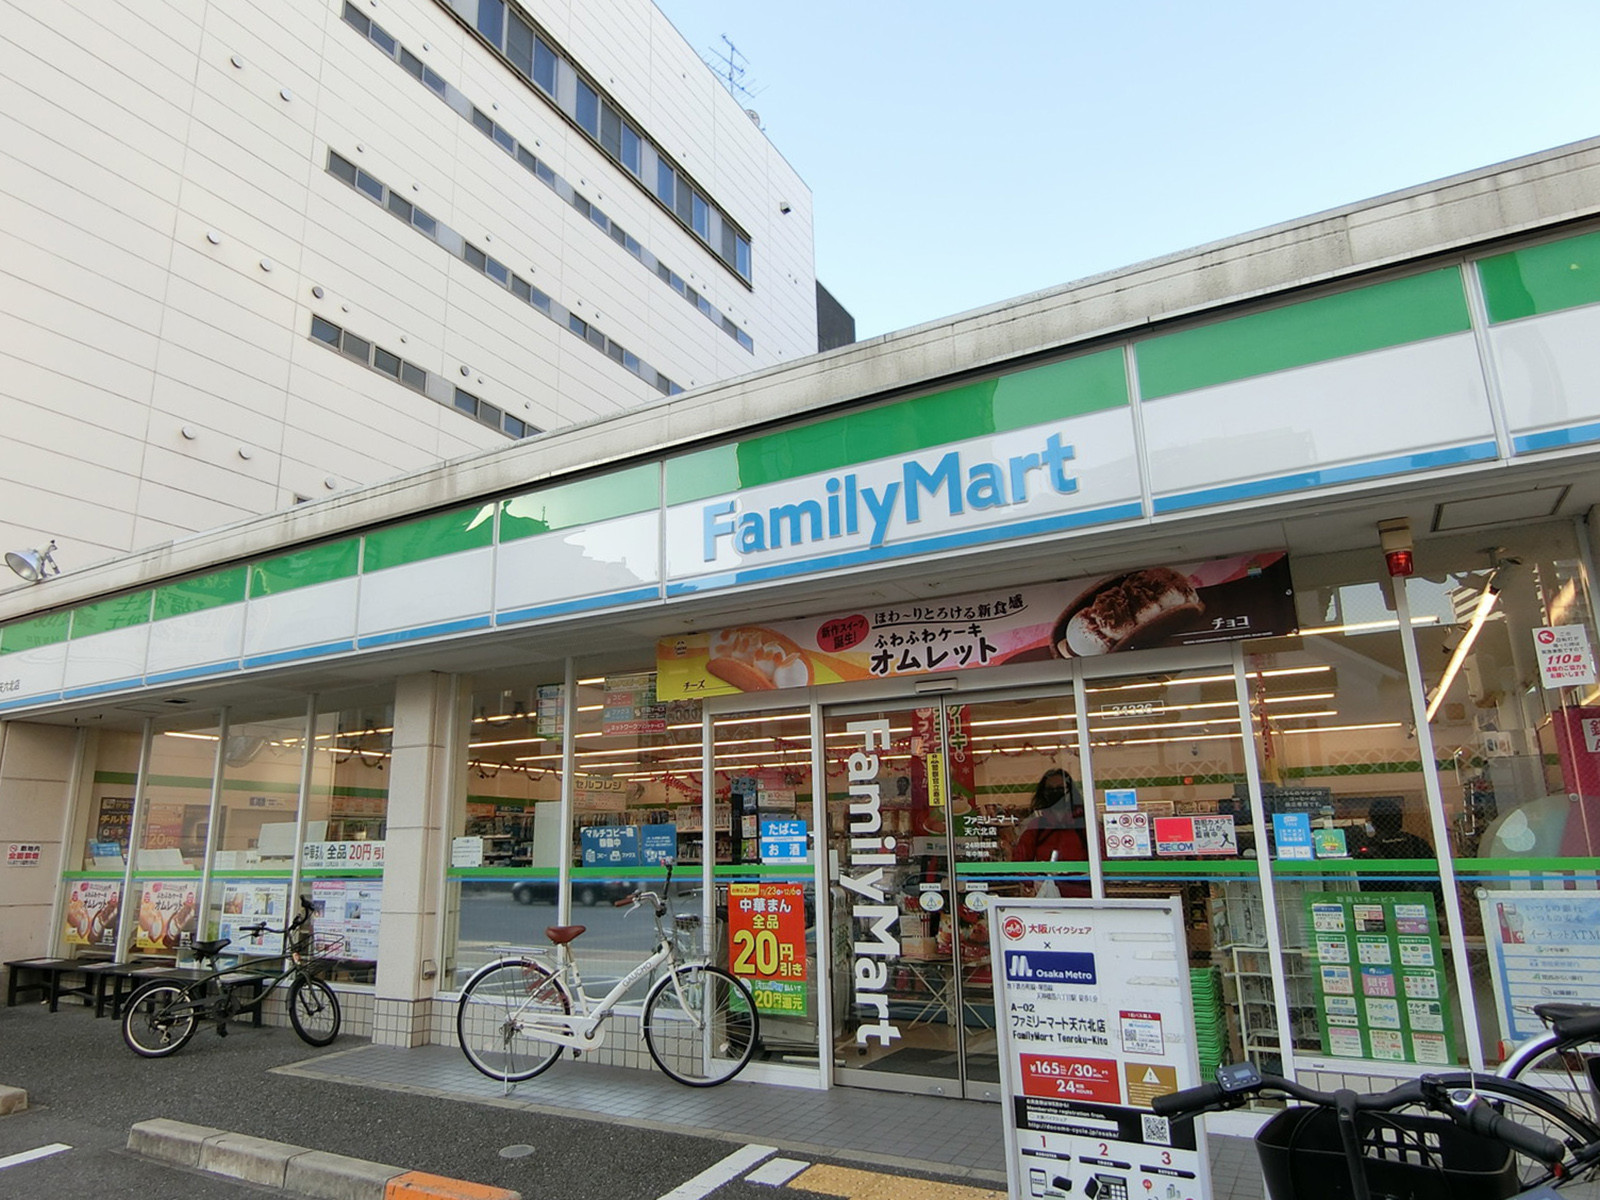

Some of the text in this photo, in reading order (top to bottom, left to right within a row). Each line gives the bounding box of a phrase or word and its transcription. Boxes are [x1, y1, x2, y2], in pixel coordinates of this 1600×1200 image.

[702, 432, 1081, 562] FamilyMart
[821, 619, 865, 639] 新作スイーツ
[1211, 615, 1250, 630] チョコ
[873, 623, 983, 649] ふわふわケーキ
[869, 636, 998, 675] オムレット
[1548, 654, 1582, 665] 110番
[1550, 670, 1586, 678] お願いします
[683, 679, 706, 692] チーズ
[962, 814, 1019, 825] ファミリーマート
[768, 823, 800, 836] たばこ
[964, 827, 998, 836] 天六北店
[327, 844, 347, 860] 全品
[349, 844, 371, 861] 20円
[1159, 842, 1194, 852] SECOM
[839, 718, 902, 1047] FamilyMart
[83, 900, 108, 909] オムレット
[154, 901, 183, 911] オムレット
[739, 897, 792, 913] 中華まん
[752, 914, 780, 929] 全品
[1028, 923, 1092, 935] 大阪バイクシェア
[780, 962, 803, 977] 引き
[1036, 969, 1092, 980] Osaka Metro
[1368, 987, 1390, 995] ATM
[1010, 1003, 1035, 1012] A-02
[1011, 1015, 1106, 1033] ファミリーマート天六北店
[1012, 1030, 1108, 1046] FamilyMart Tenroku-Kita
[1056, 1079, 1076, 1093] 24
[1026, 1105, 1058, 1114] Membership
[1059, 1108, 1091, 1118] registration
[1040, 1135, 1047, 1148] 1
[1098, 1143, 1109, 1156] 2
[1161, 1151, 1172, 1166] 3
